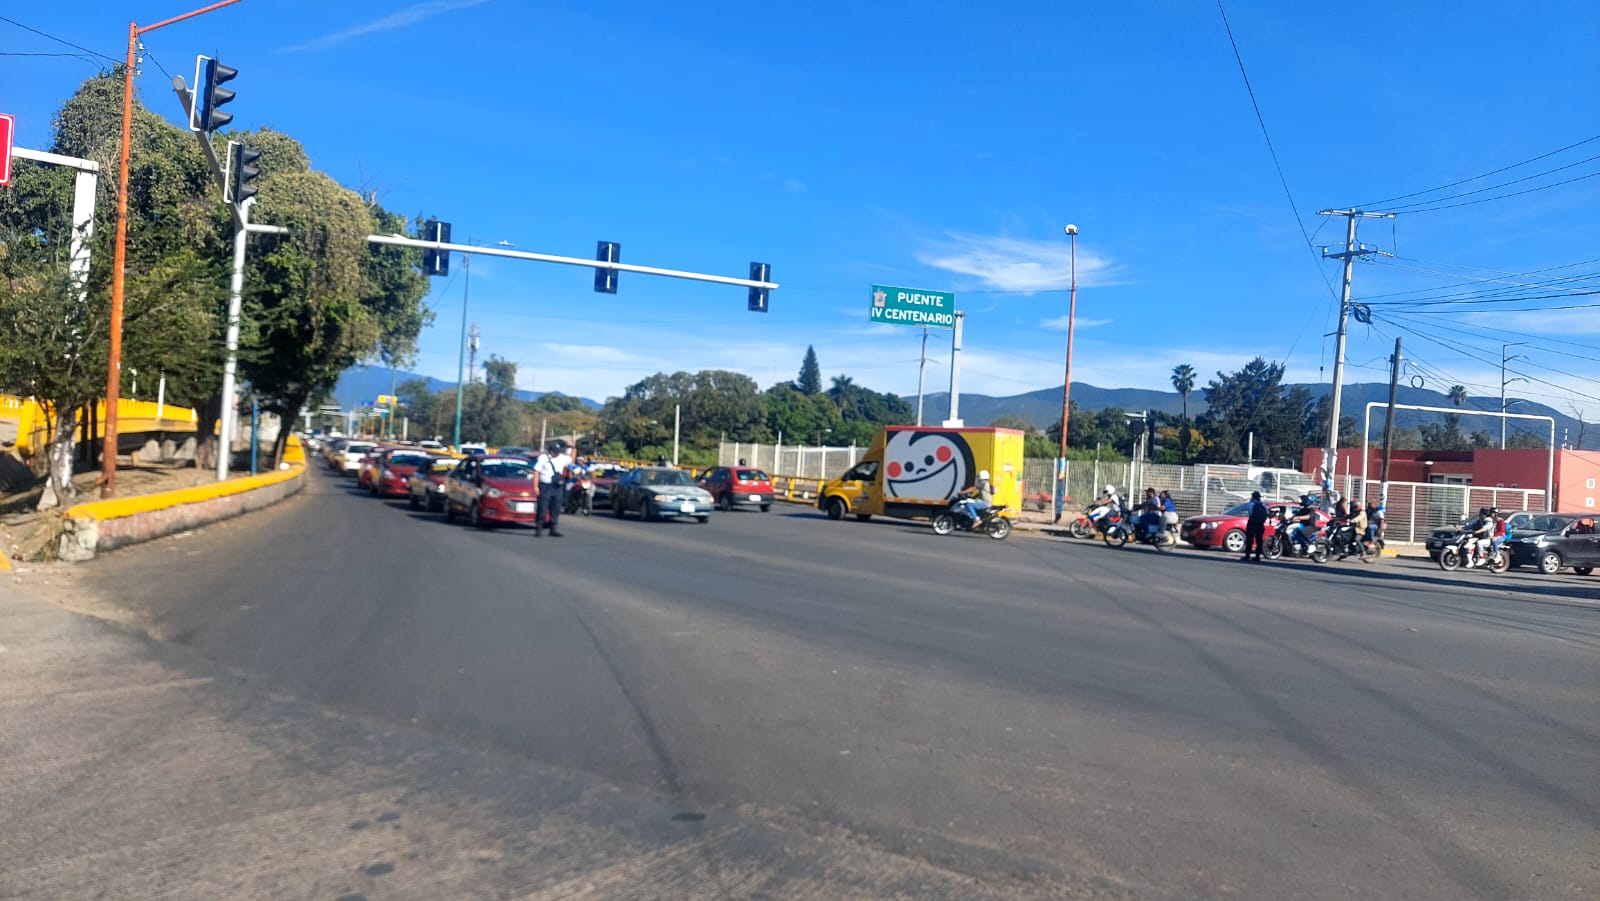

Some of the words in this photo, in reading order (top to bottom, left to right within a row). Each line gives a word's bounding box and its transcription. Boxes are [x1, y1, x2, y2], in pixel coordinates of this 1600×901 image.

[898, 292, 944, 307] PUENTE
[871, 307, 883, 318] IV
[885, 308, 953, 325] CENTENARIO
